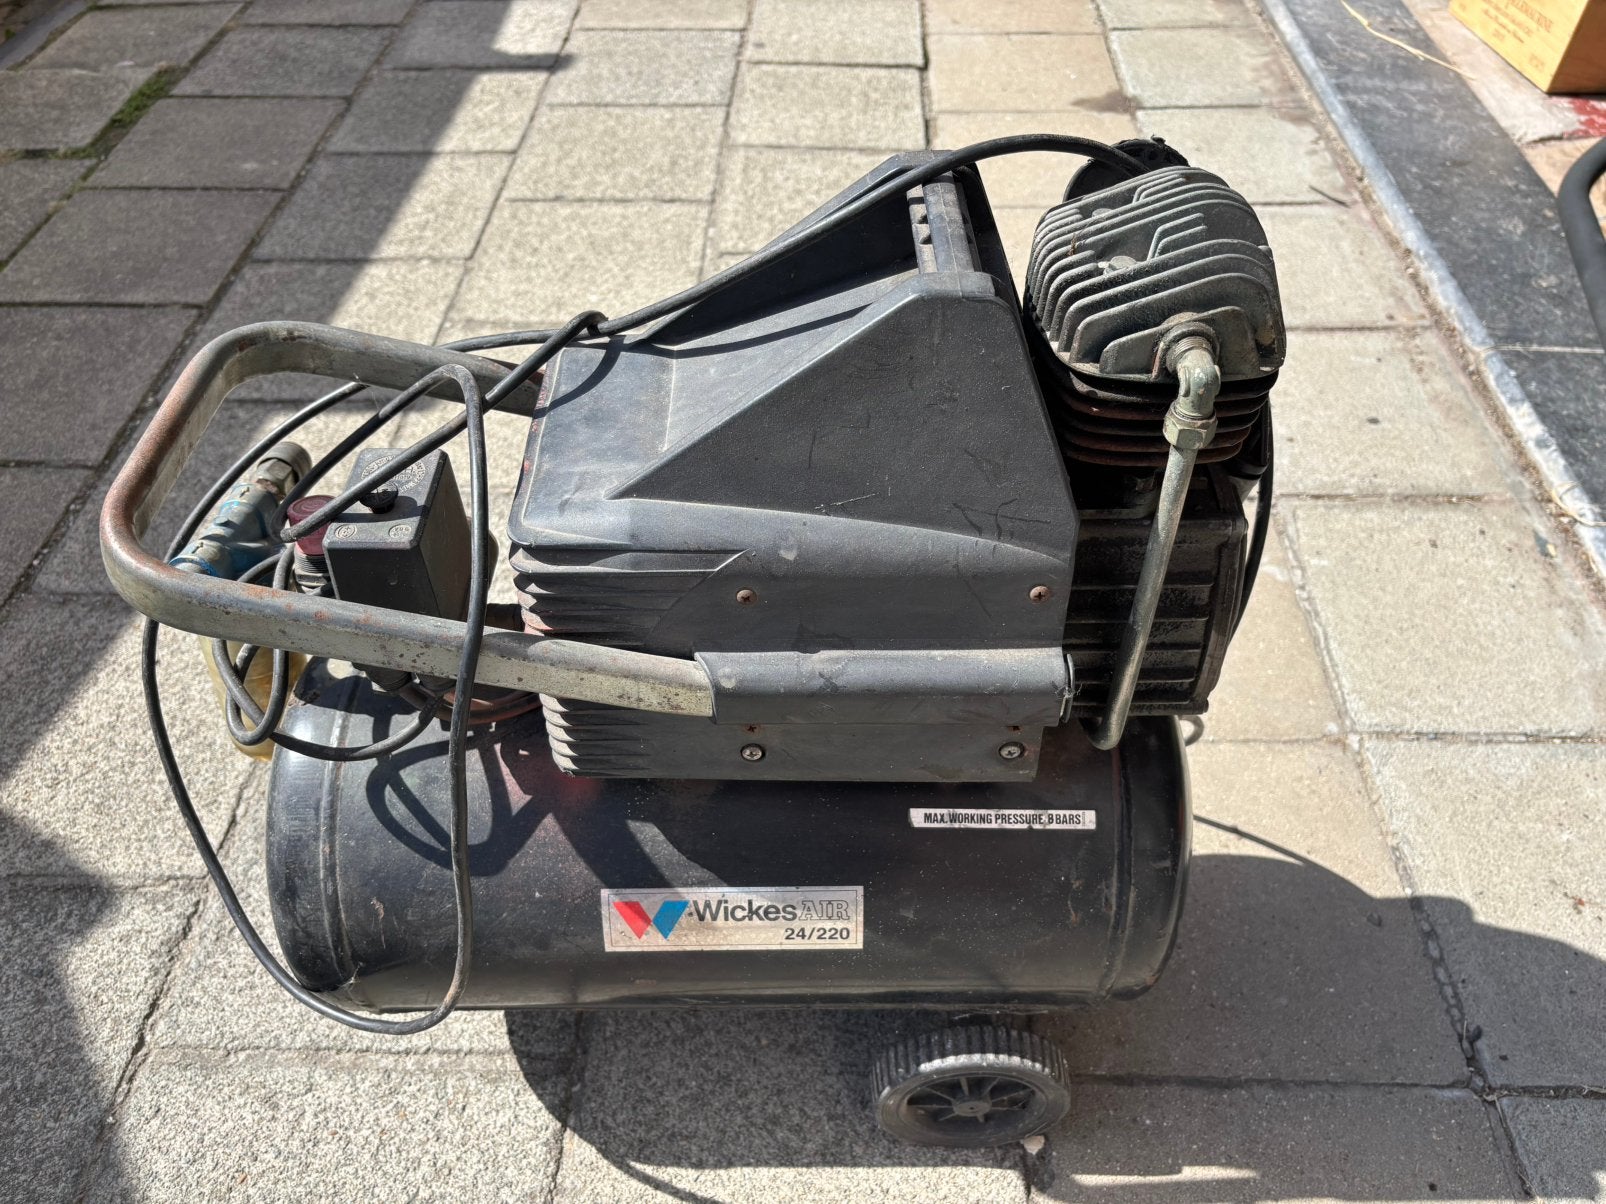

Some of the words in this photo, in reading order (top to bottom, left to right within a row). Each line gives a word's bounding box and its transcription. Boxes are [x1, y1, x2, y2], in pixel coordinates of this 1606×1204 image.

[923, 812, 948, 824] MAX.
[949, 812, 993, 825] WORKING
[994, 813, 1044, 825] PRESSURE
[1047, 813, 1055, 825] 8
[1055, 813, 1081, 825] BARS
[784, 926, 851, 941] 24/220
